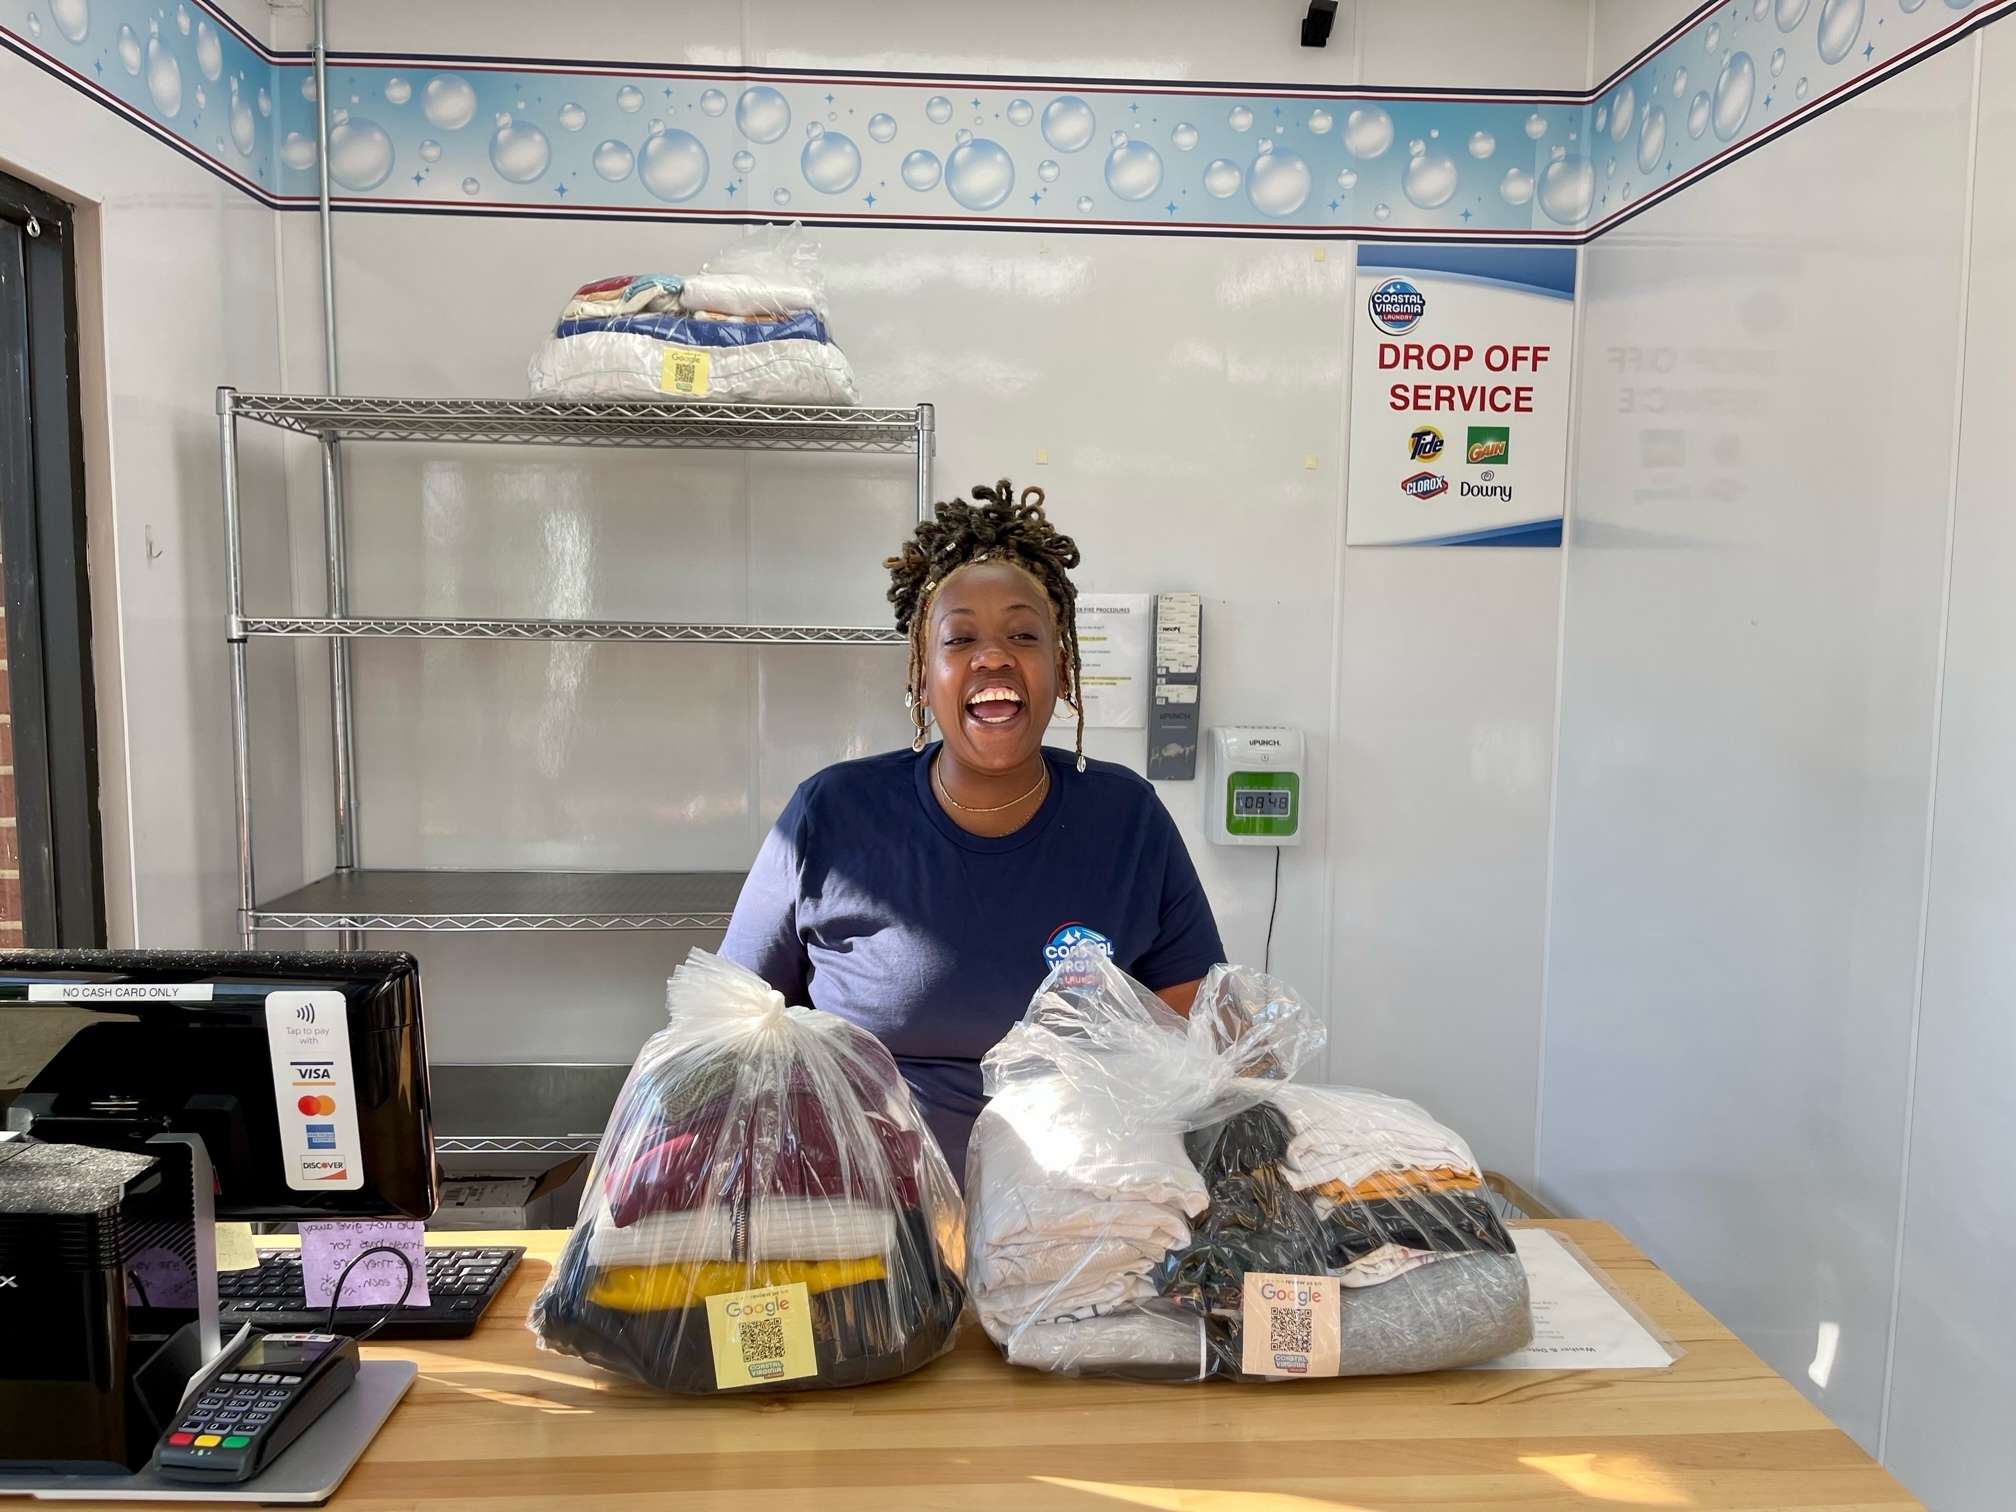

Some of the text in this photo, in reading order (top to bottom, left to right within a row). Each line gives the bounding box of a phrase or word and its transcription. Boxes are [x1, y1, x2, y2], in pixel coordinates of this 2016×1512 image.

[1374, 294, 1423, 304] COASTAL
[1375, 303, 1421, 313] VIRGINIA
[1379, 343, 1551, 372] DROP OFF
[1389, 383, 1534, 413] SERVICE
[1410, 430, 1507, 462] Tide GAIN
[1406, 478, 1512, 502] CLOROX Downy
[62, 987, 180, 998] NO CASH CARD ONLY
[286, 1026, 330, 1038] Tap to pay
[297, 1068, 331, 1079] VISA
[303, 1161, 344, 1170] DISCOVER
[1261, 1283, 1321, 1306] Google
[726, 1295, 790, 1318] Google
